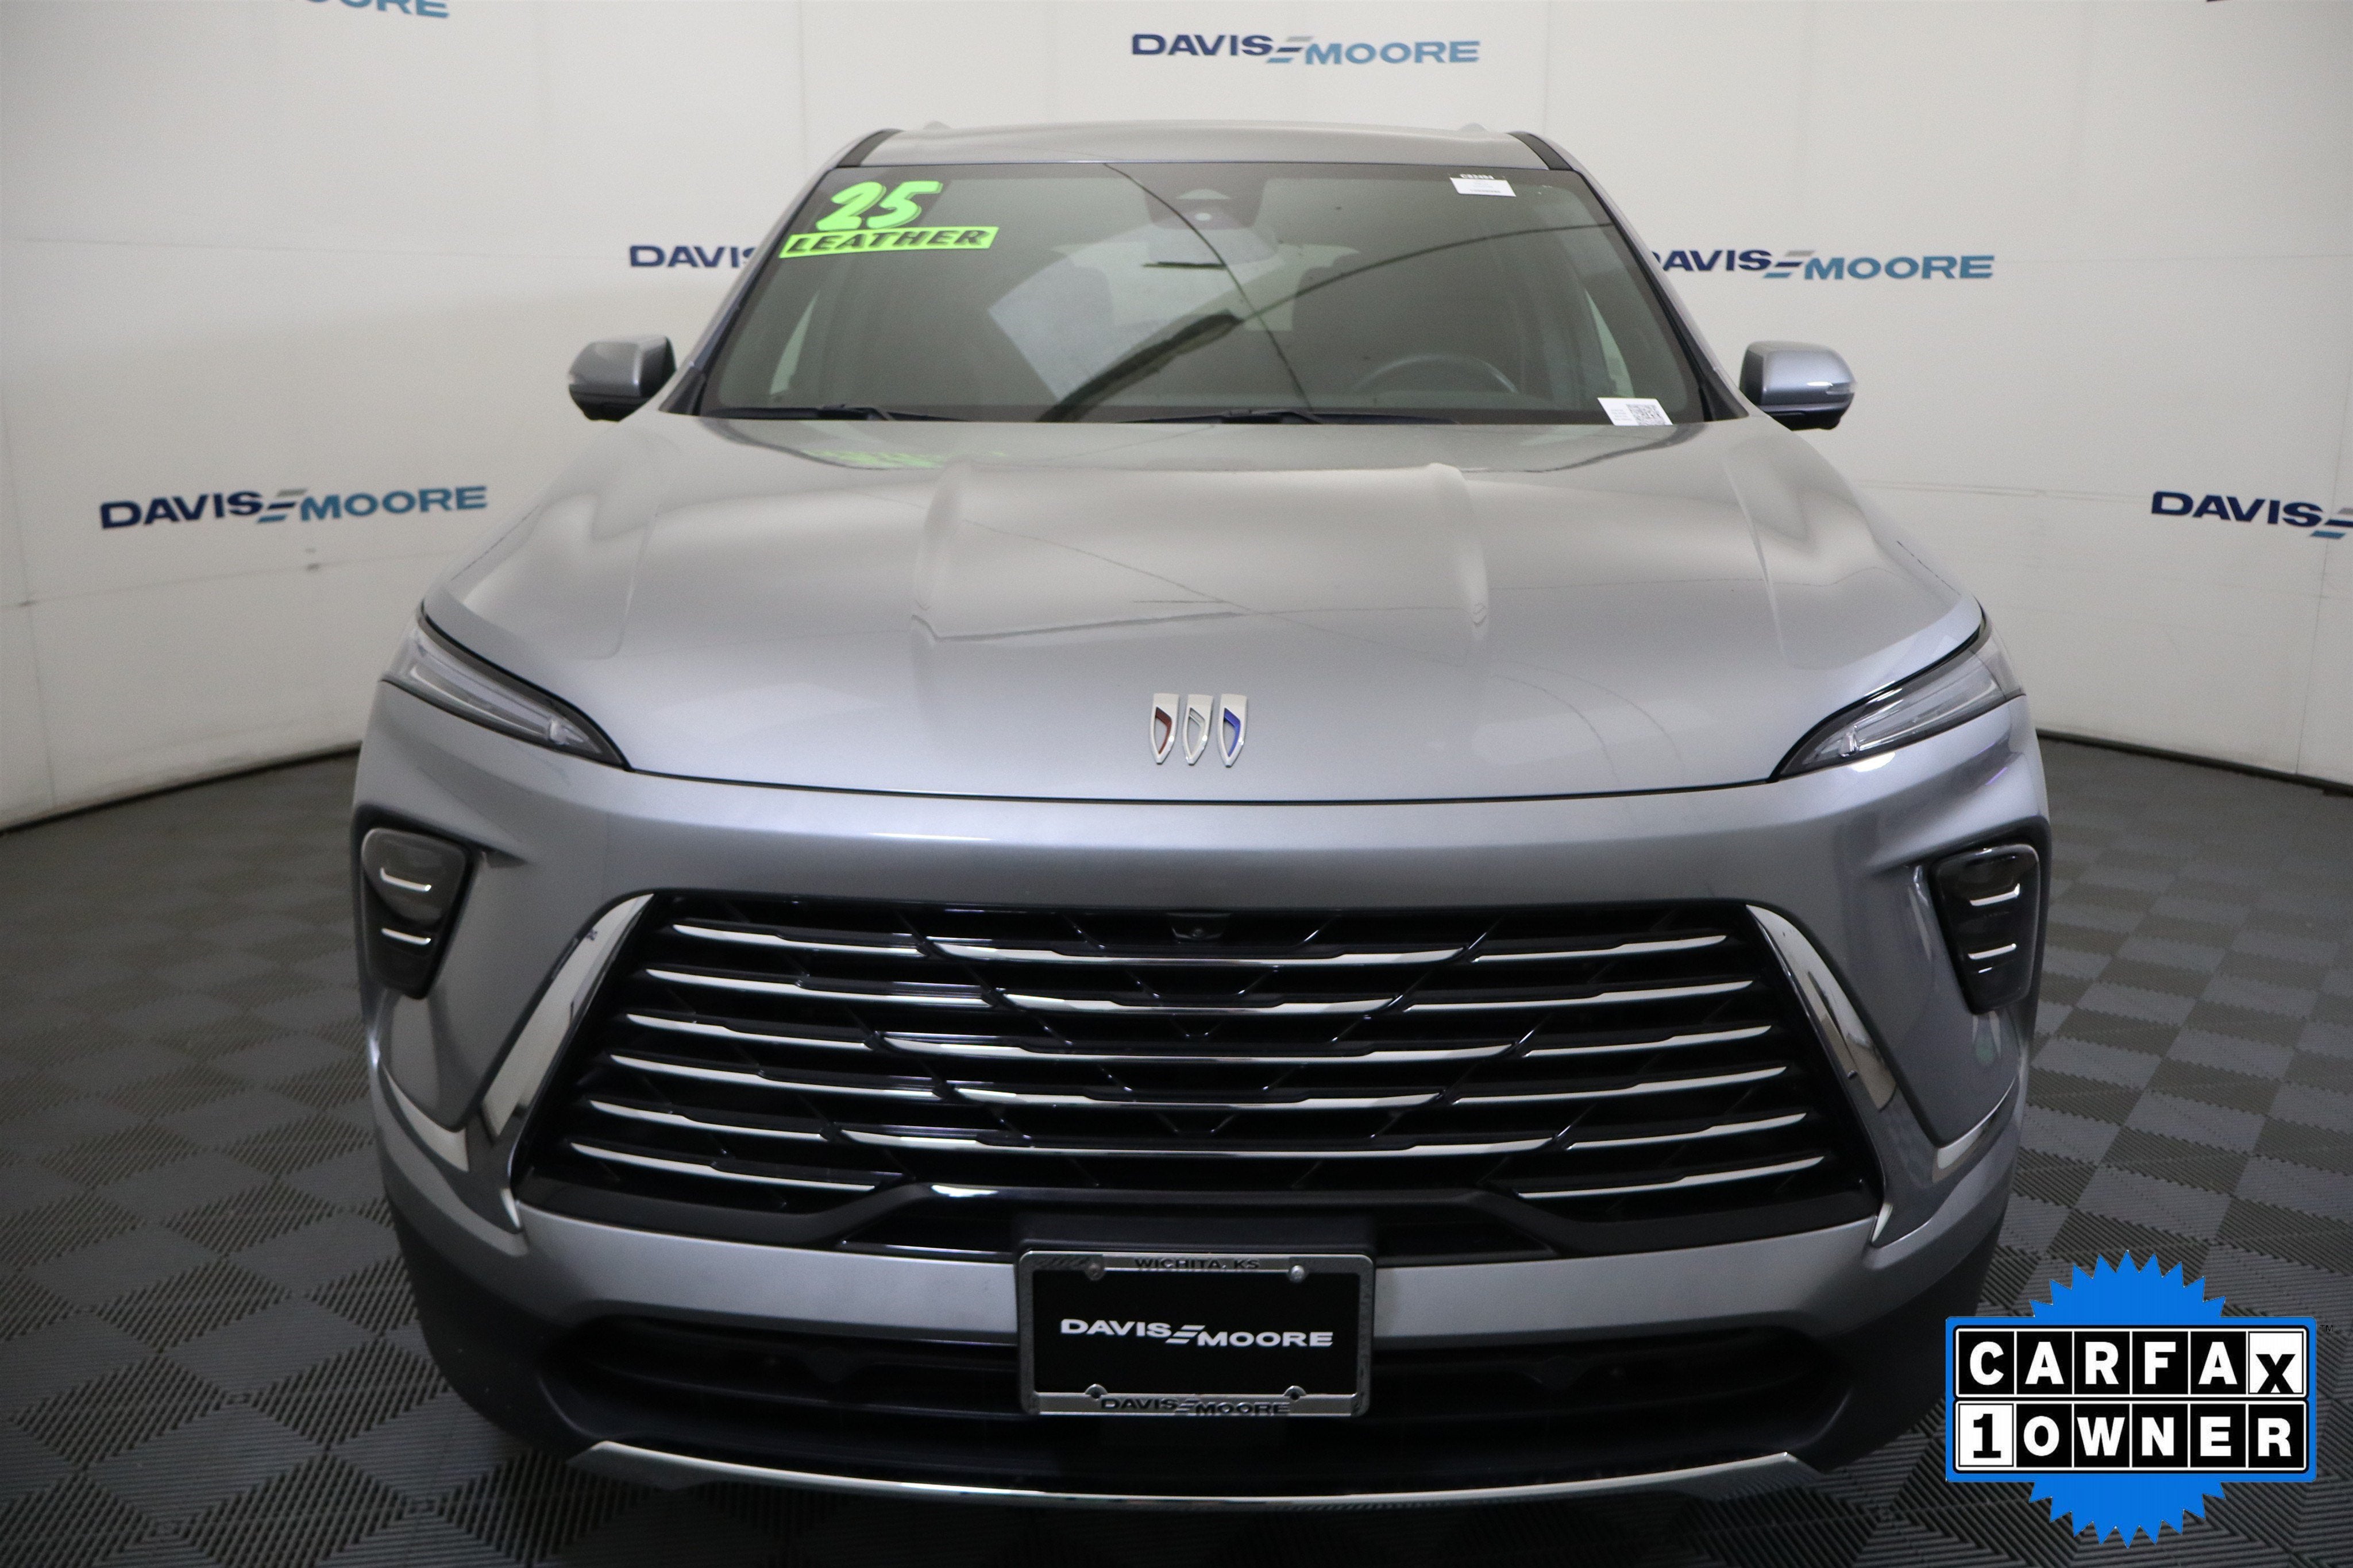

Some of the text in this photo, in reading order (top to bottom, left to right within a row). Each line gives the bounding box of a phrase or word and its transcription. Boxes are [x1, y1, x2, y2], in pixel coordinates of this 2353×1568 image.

[1132, 34, 1480, 64] DAVIS MOORE
[816, 180, 943, 231] 25
[630, 245, 757, 268] DAVI
[786, 230, 989, 254] LEATHER
[1652, 249, 1995, 280] AVIS MOORE
[99, 486, 487, 529] DAVIS MOORE
[2151, 491, 2323, 527] DAVIS
[1233, 1259, 1260, 1269] KS
[1060, 1319, 1333, 1347] DAVIS MOORE
[1101, 1398, 1291, 1415] DAVIS MOORE
